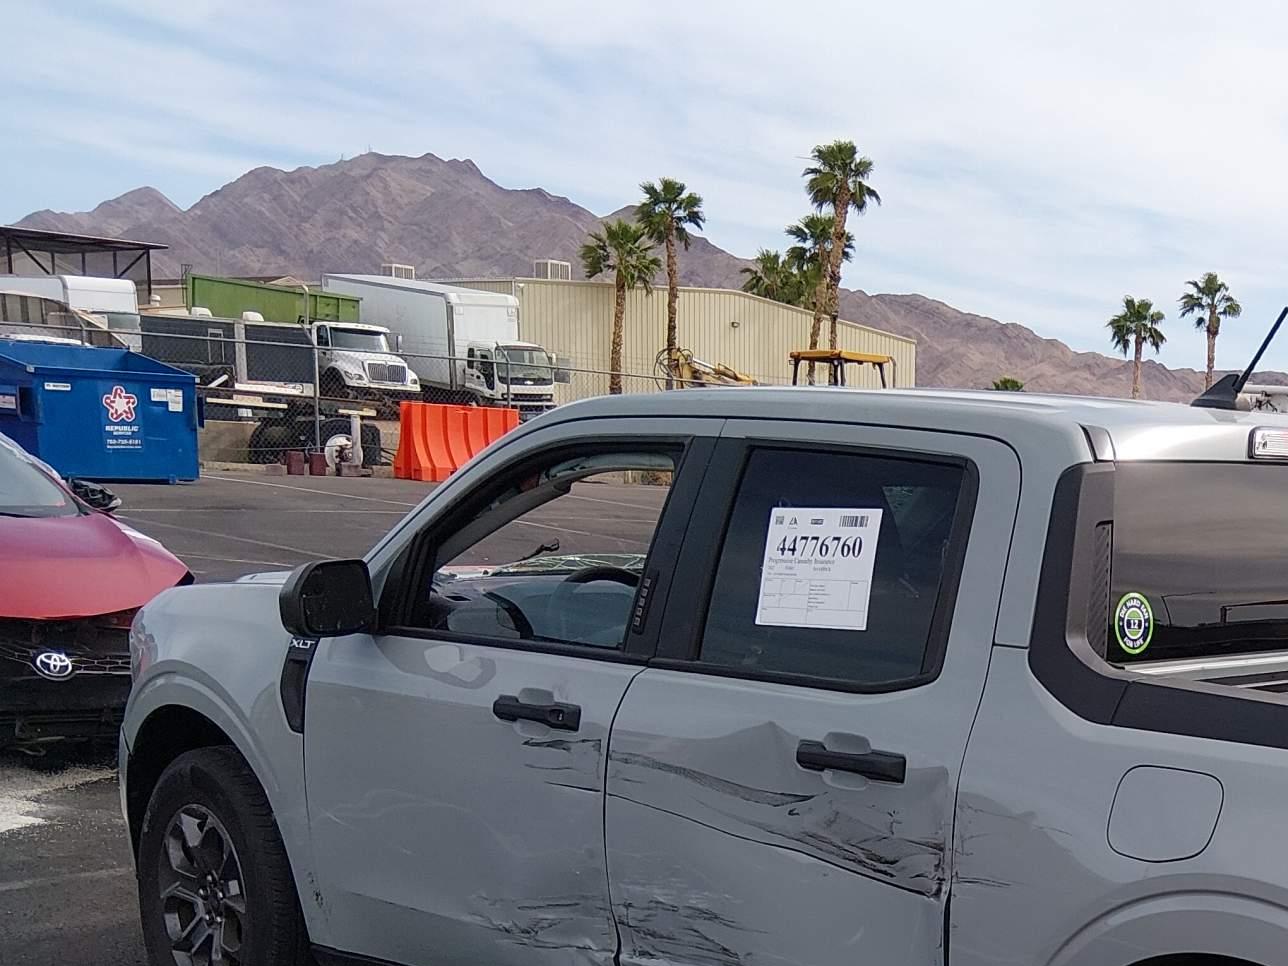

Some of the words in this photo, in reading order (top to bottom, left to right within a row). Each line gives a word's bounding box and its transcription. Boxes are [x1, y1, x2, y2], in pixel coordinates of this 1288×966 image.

[776, 535, 863, 558] 44776760
[1130, 619, 1139, 629] 12
[290, 638, 316, 649] XLT
